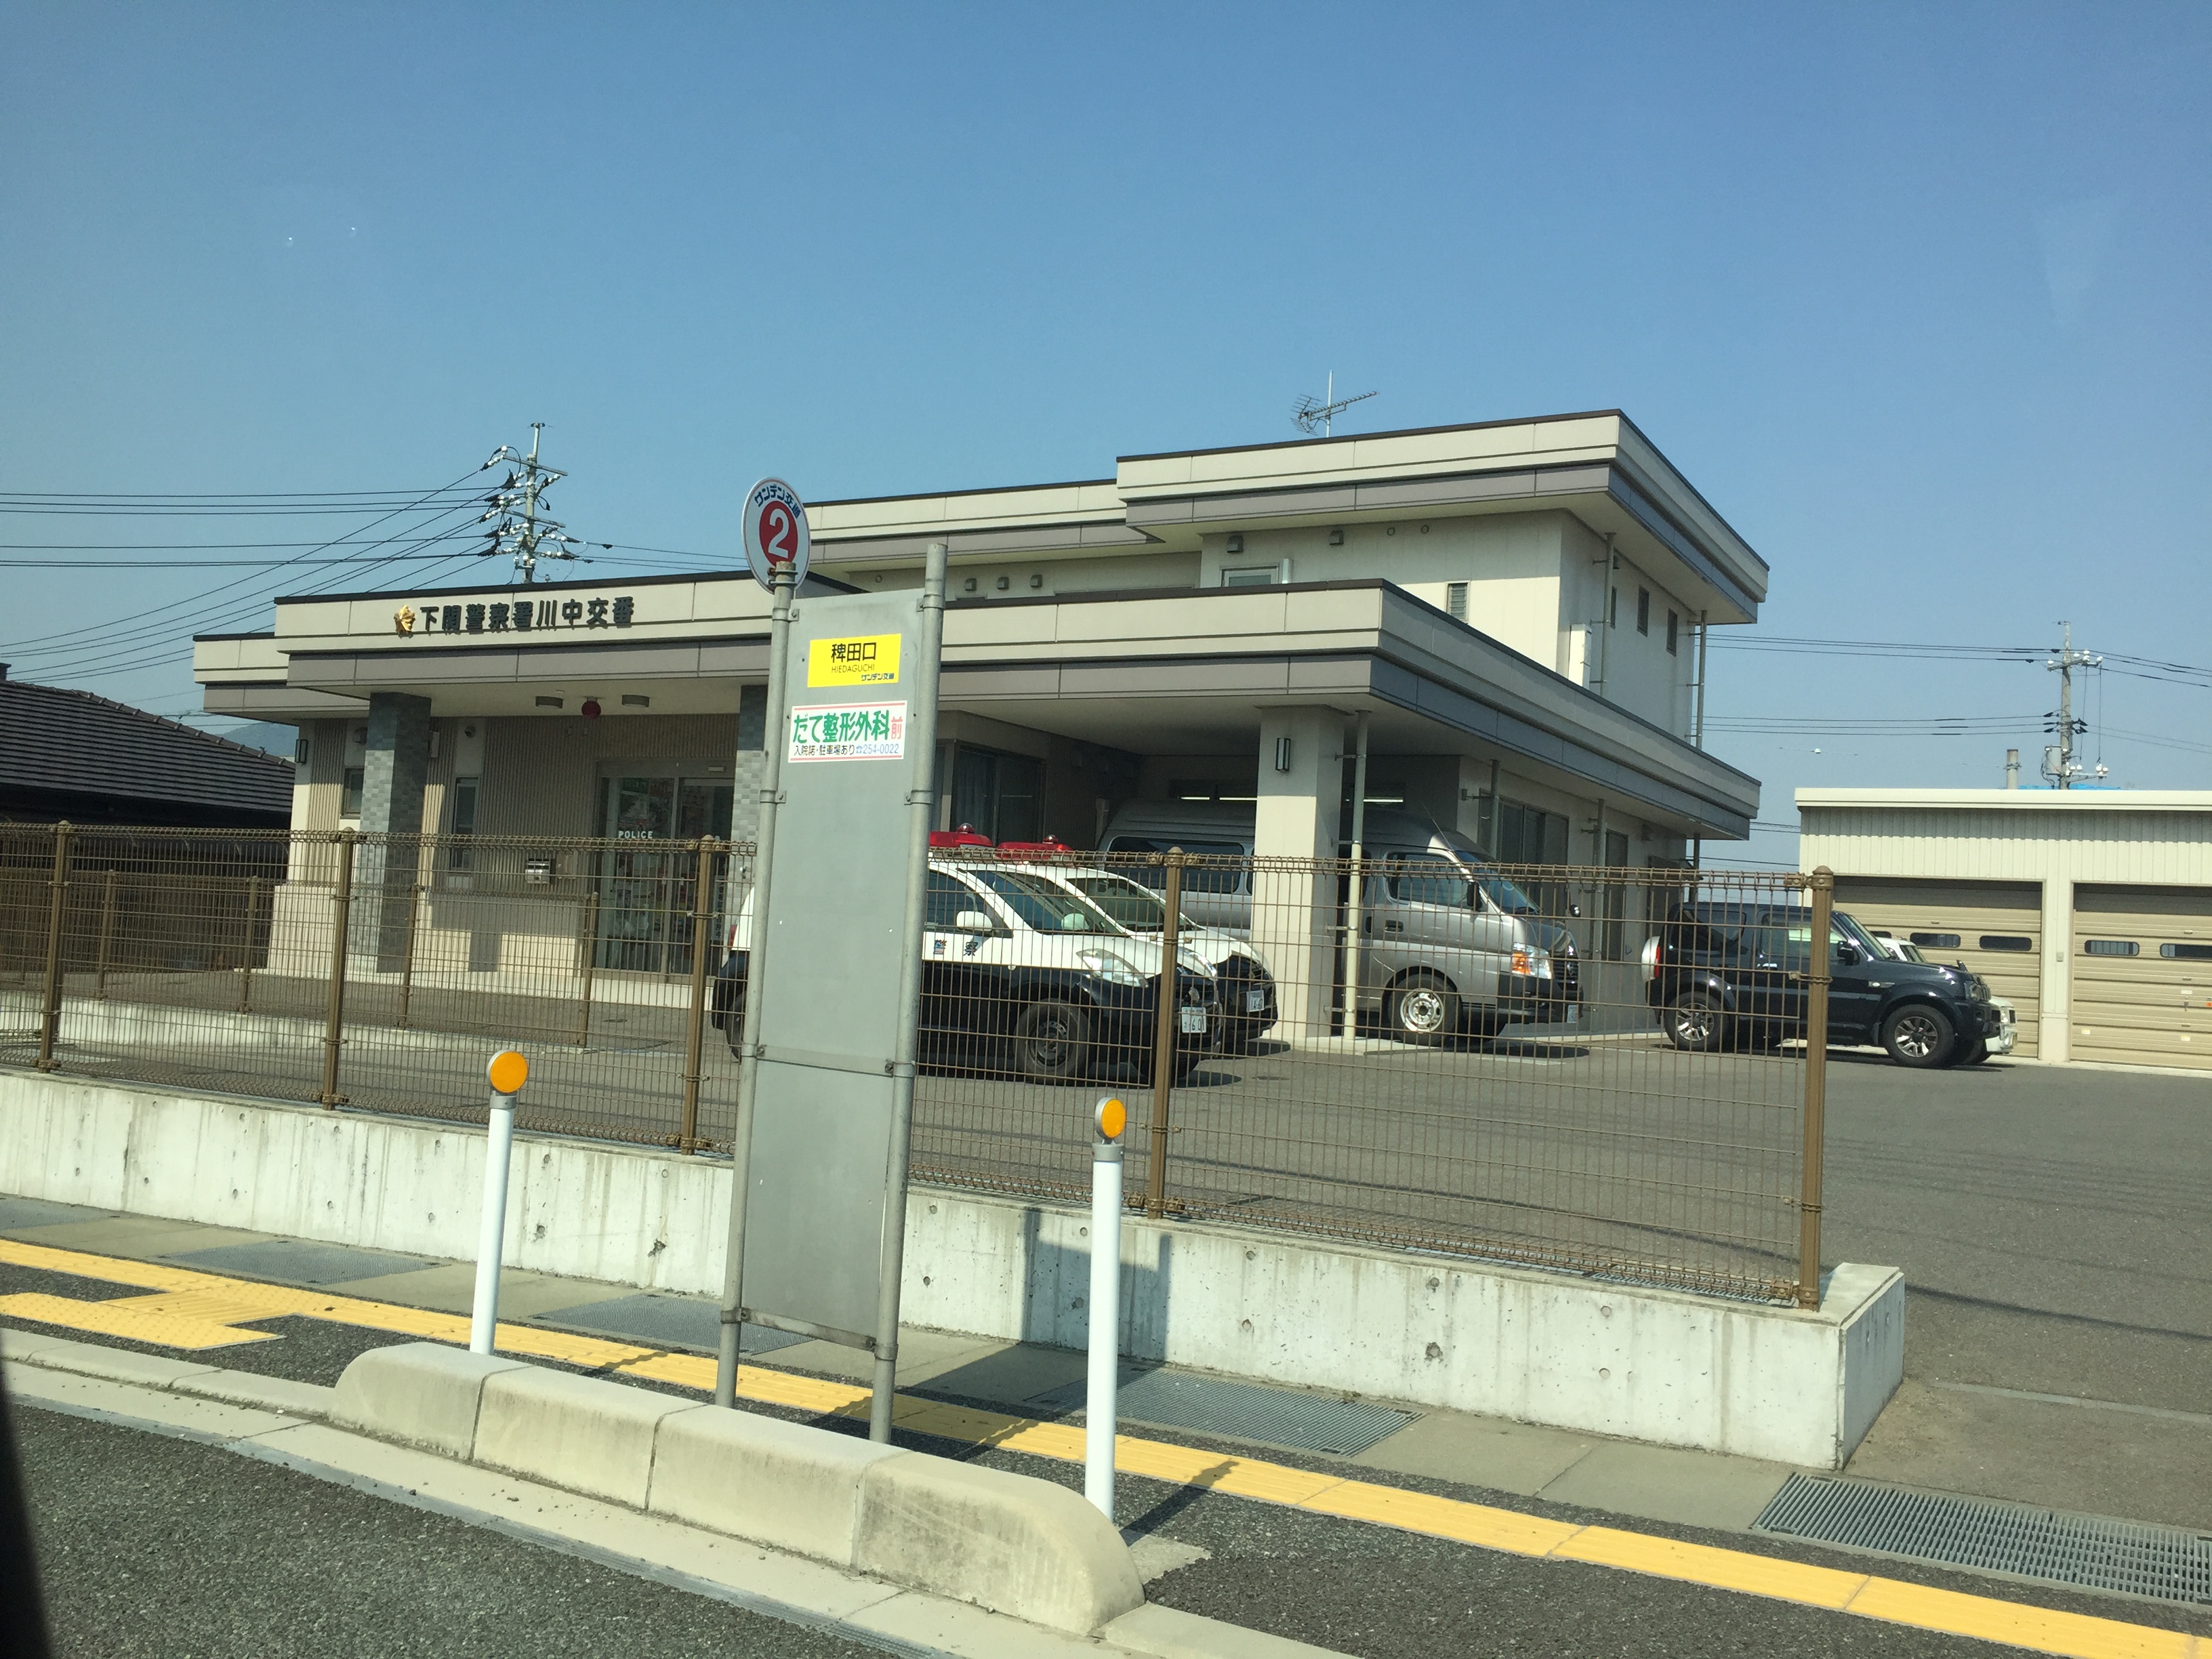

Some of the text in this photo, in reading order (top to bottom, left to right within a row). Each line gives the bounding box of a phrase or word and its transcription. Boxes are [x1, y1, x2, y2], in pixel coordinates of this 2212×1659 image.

[768, 508, 790, 559] 2
[419, 596, 634, 634] 下関警察署川中交番
[831, 642, 876, 663] 稗田口
[832, 664, 875, 673] HIEDAGUCHI
[618, 830, 653, 839] POLICE
